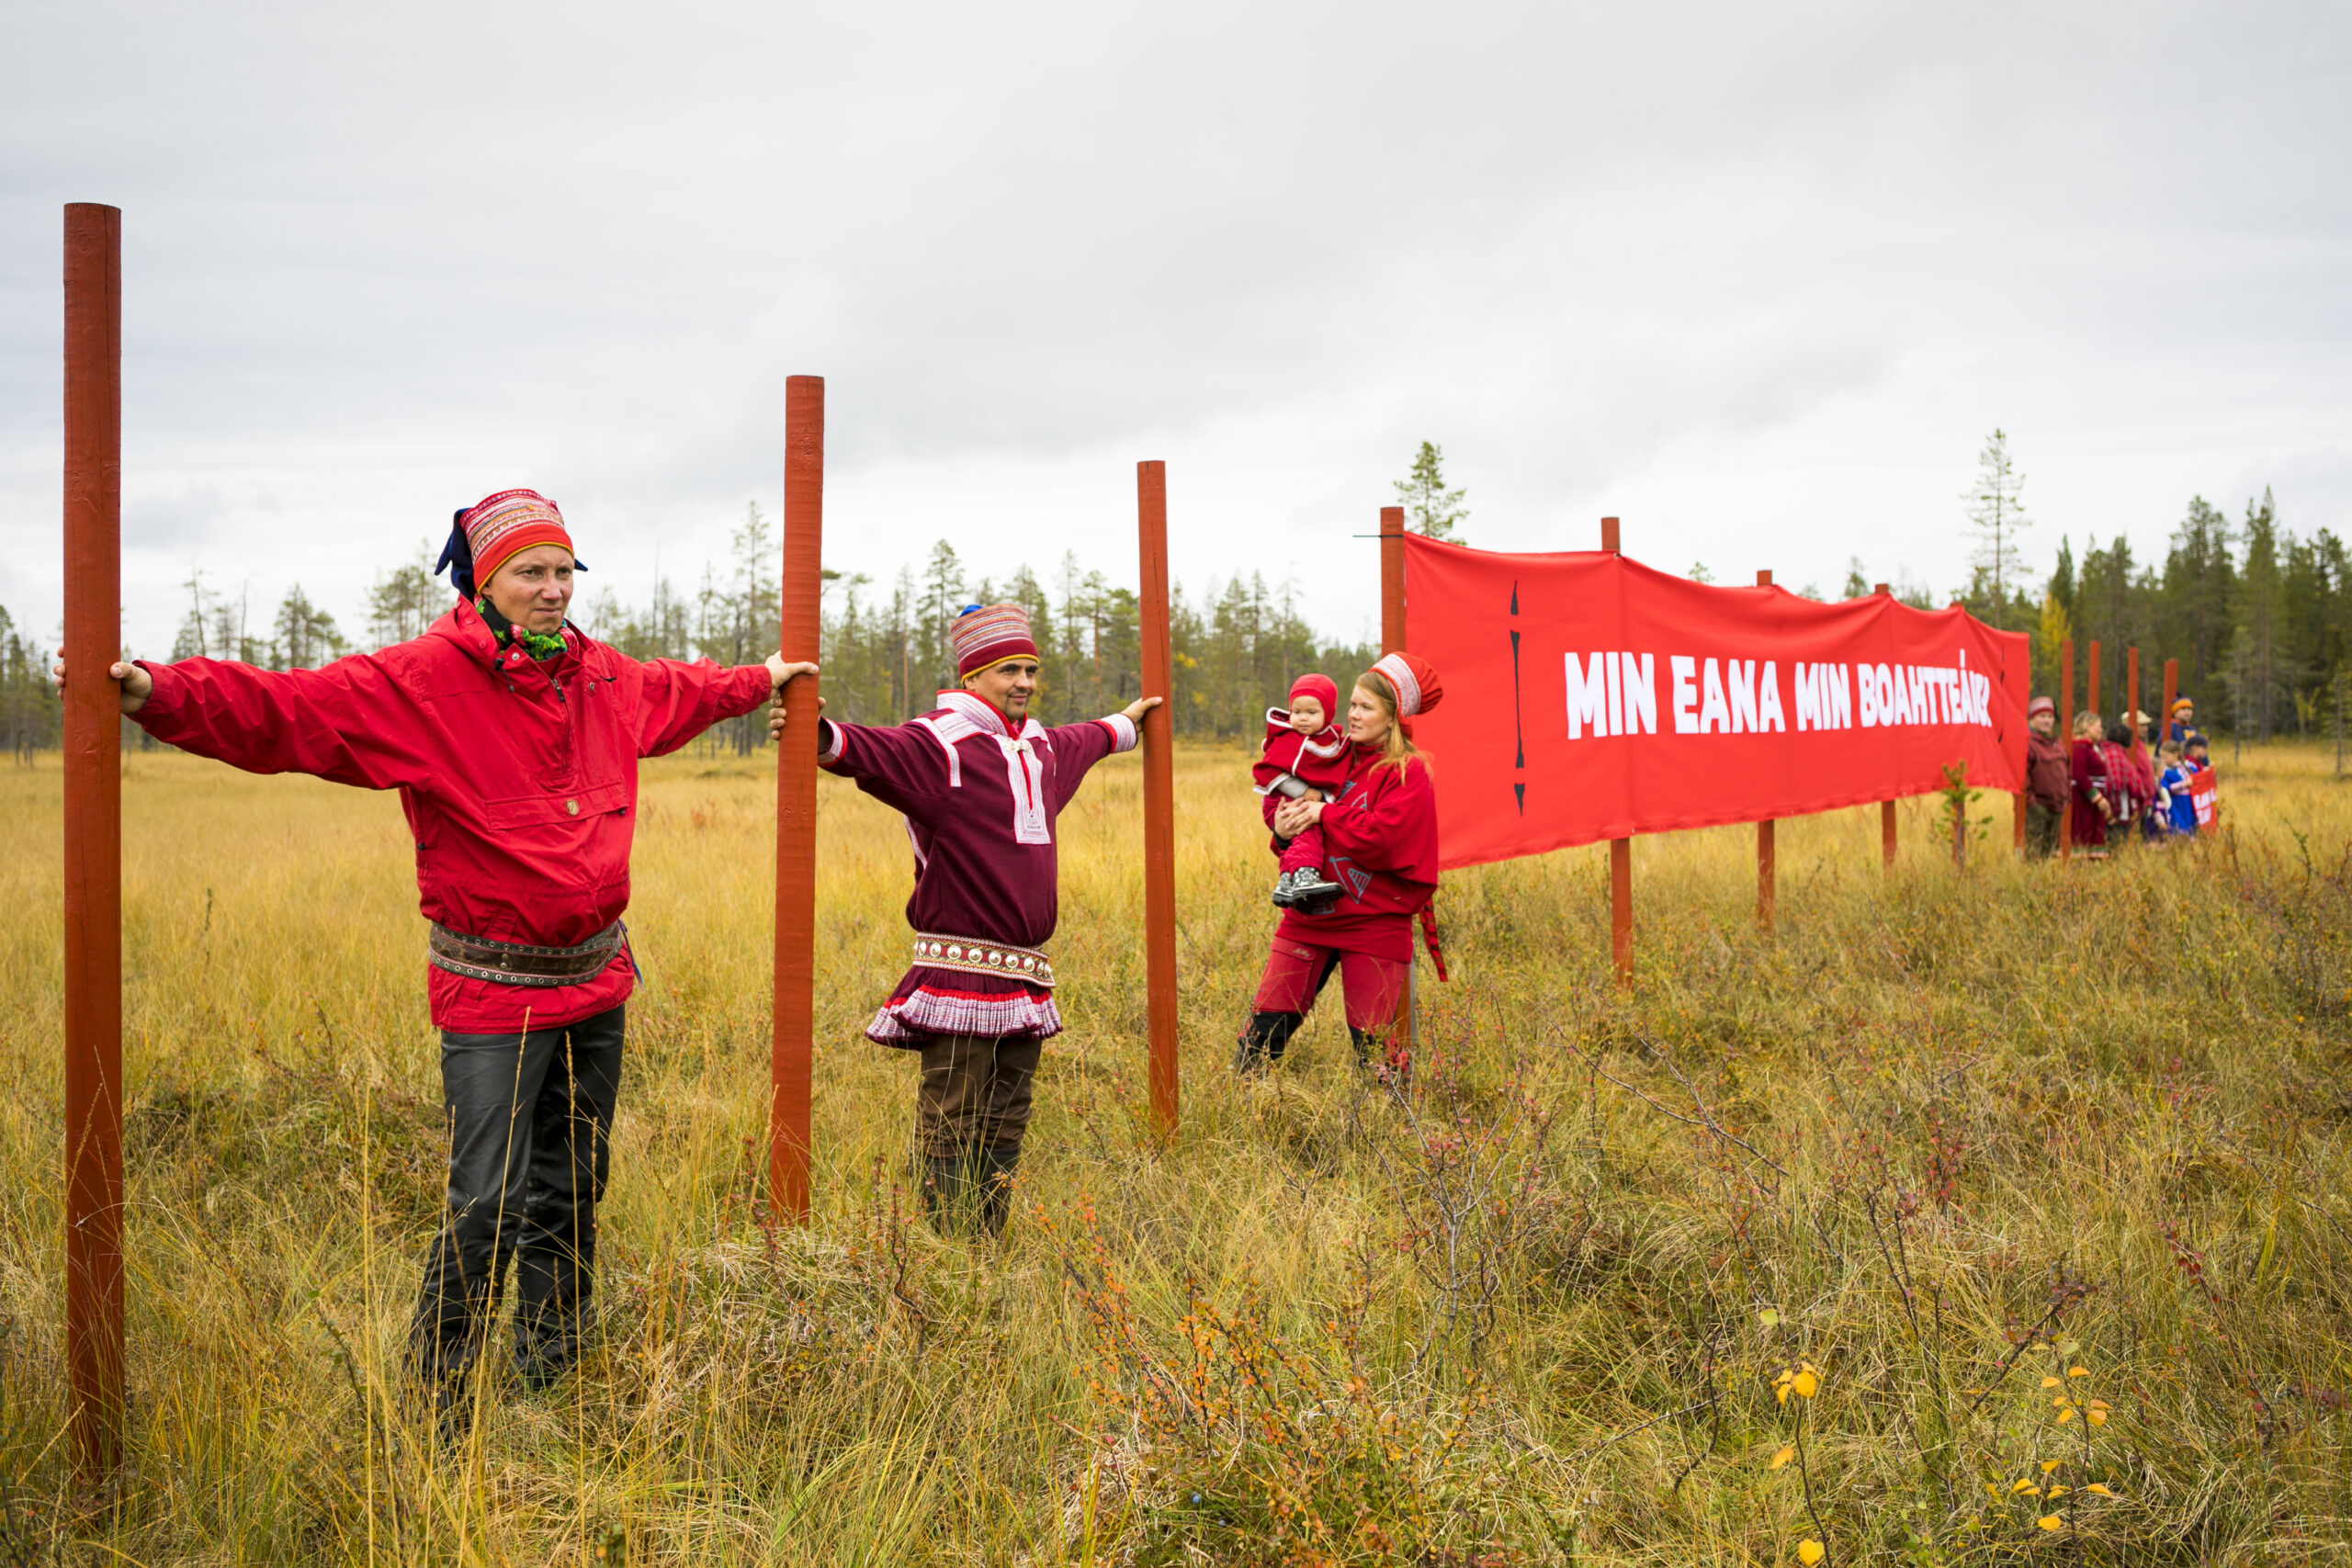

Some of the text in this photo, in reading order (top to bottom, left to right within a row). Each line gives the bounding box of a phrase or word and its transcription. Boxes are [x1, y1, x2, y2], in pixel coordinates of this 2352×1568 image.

[1565, 651, 1657, 740] MIN
[1669, 655, 1786, 734] EANA
[1794, 661, 1852, 732] MIN
